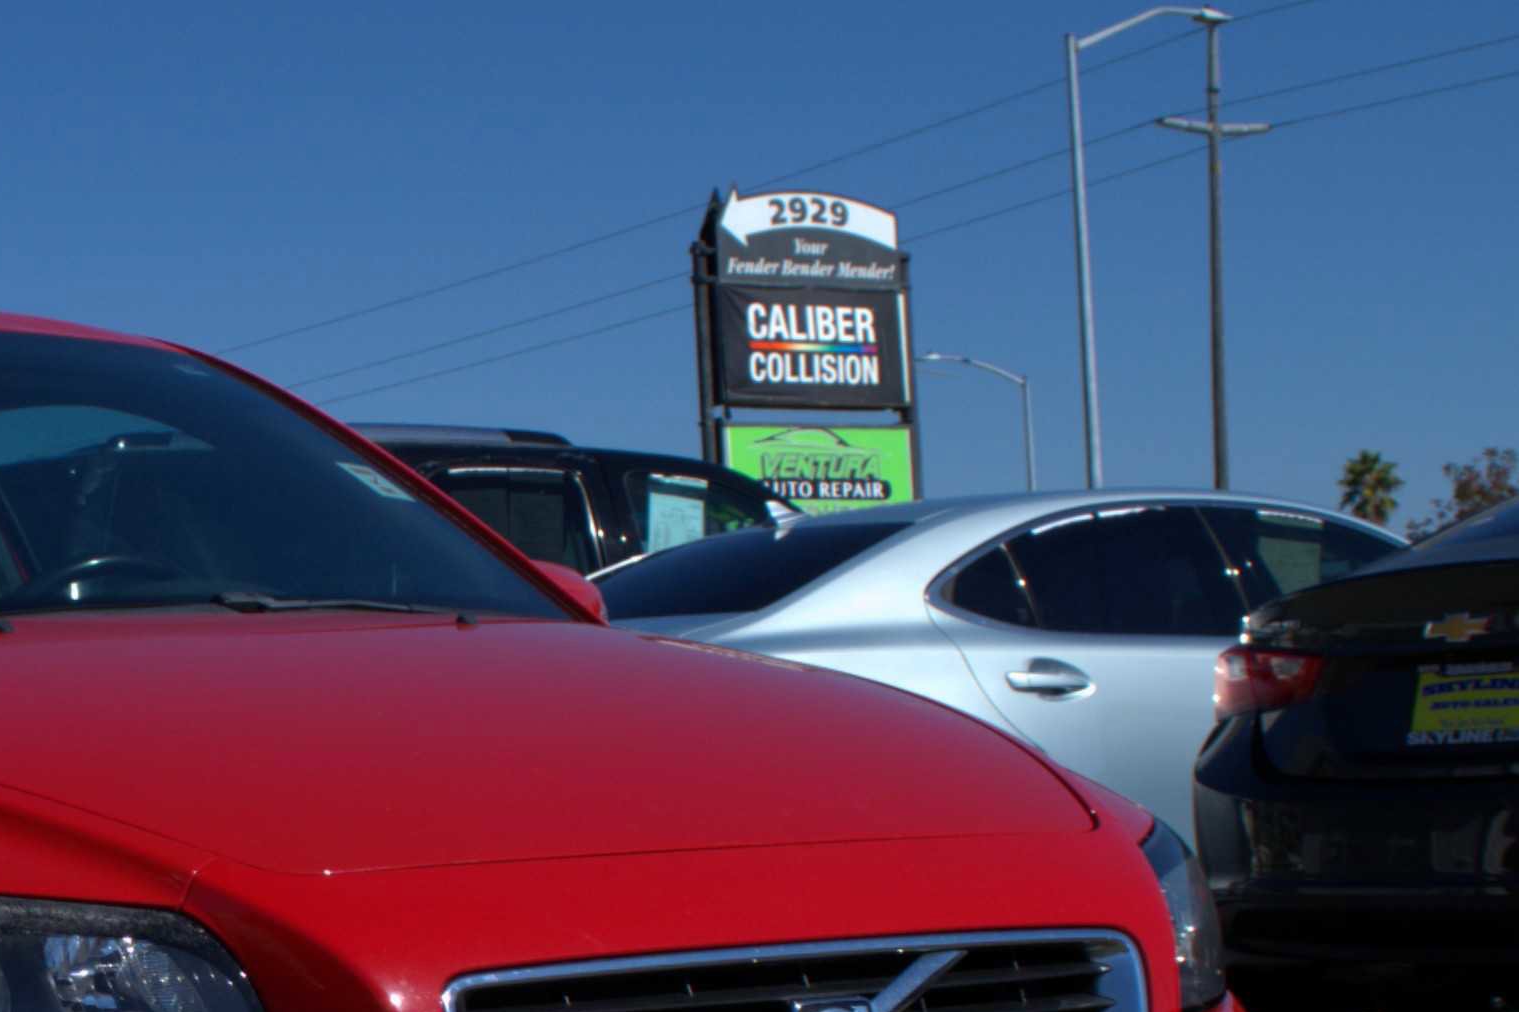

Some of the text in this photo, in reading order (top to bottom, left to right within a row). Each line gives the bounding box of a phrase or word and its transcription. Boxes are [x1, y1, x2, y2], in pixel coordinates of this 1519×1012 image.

[768, 197, 850, 226] 2929
[793, 238, 828, 255] Your
[727, 257, 895, 280] Fender Bender Mender!
[747, 302, 877, 343] CALIBER
[749, 352, 880, 385] COLLISION
[760, 451, 882, 481] VENTURA
[763, 480, 885, 498] UTO REPAIR
